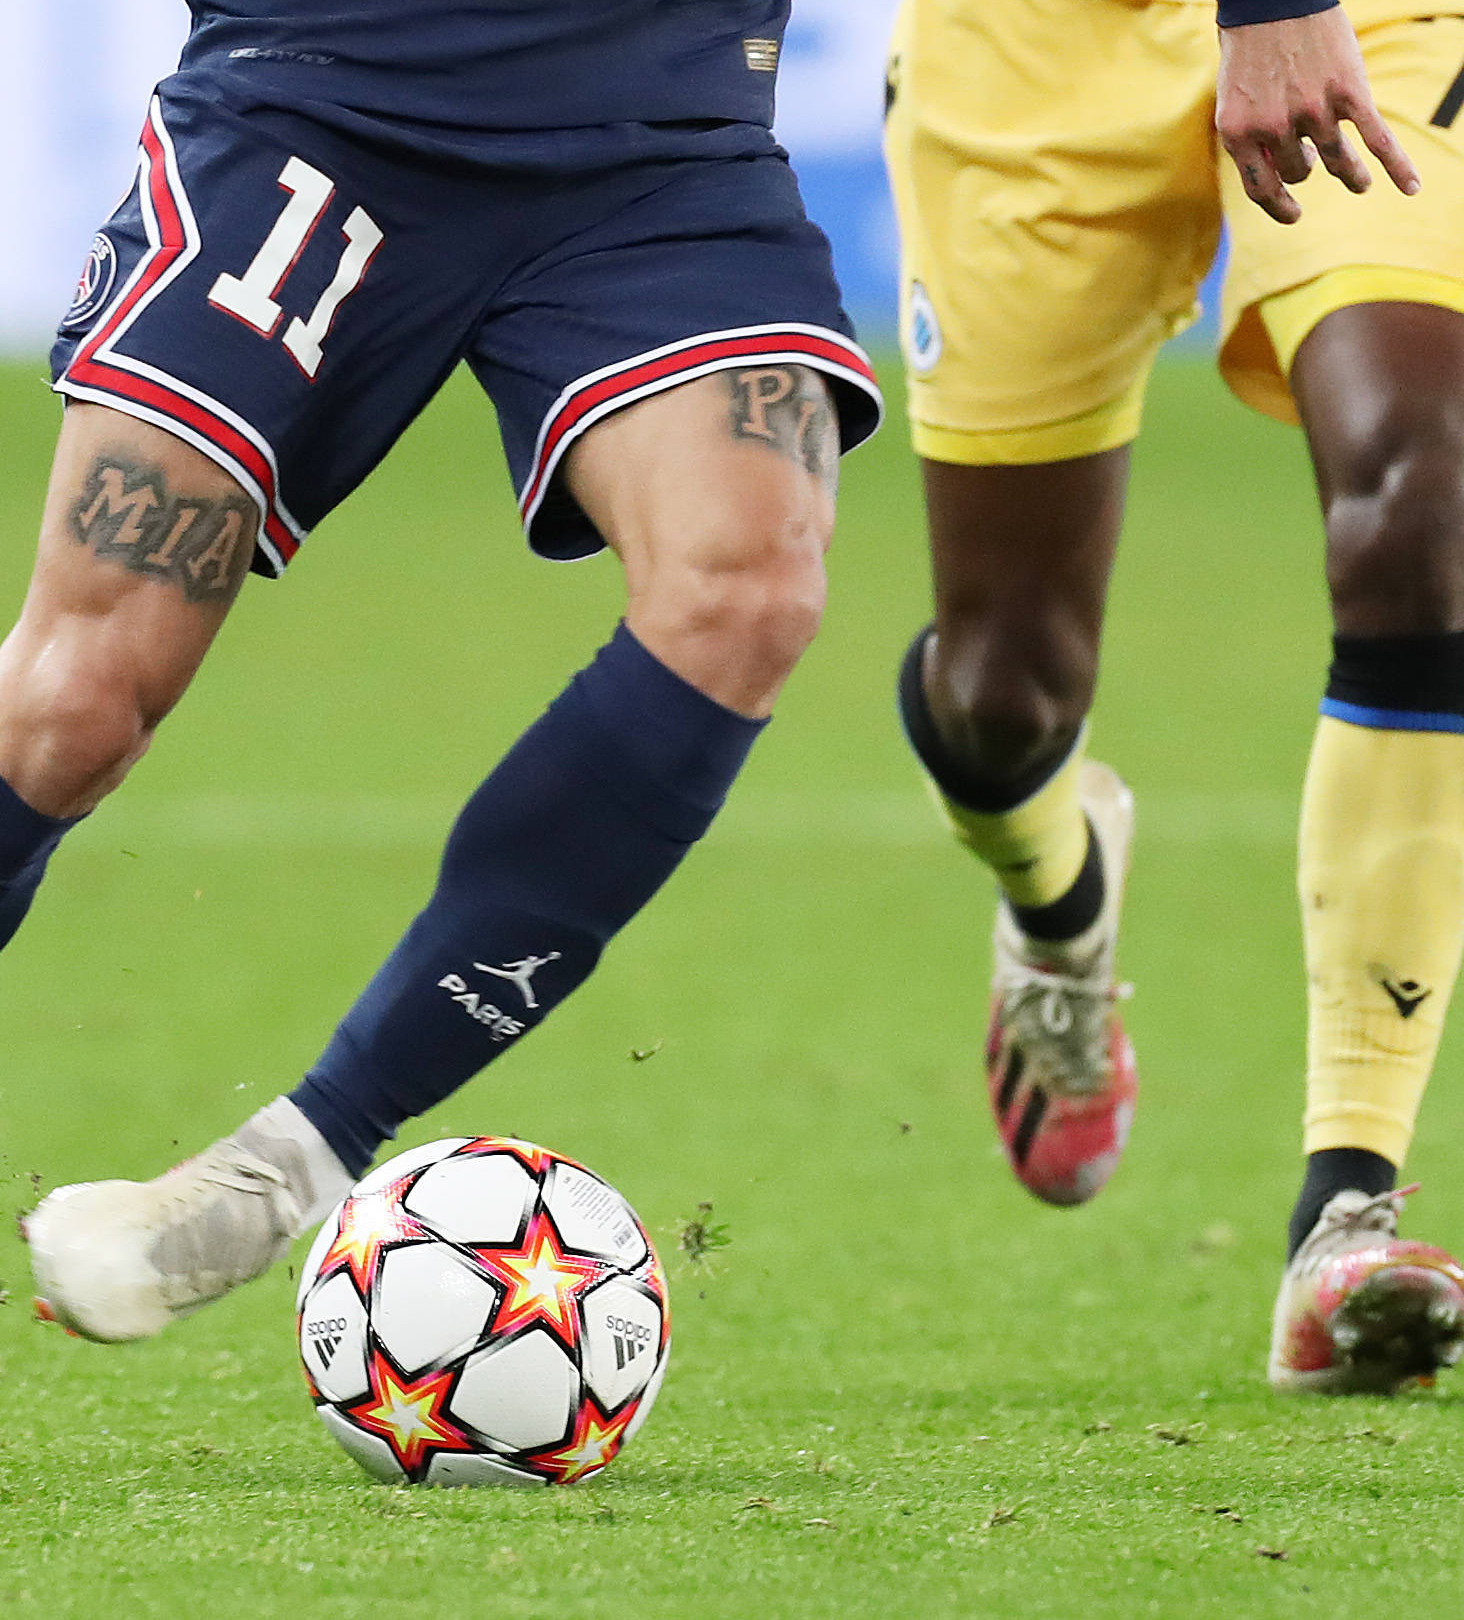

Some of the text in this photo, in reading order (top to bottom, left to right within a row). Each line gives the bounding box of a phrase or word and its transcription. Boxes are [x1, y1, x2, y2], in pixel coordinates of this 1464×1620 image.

[207, 156, 384, 380] 11
[79, 466, 243, 590] MIA
[606, 1315, 652, 1342] adidas
